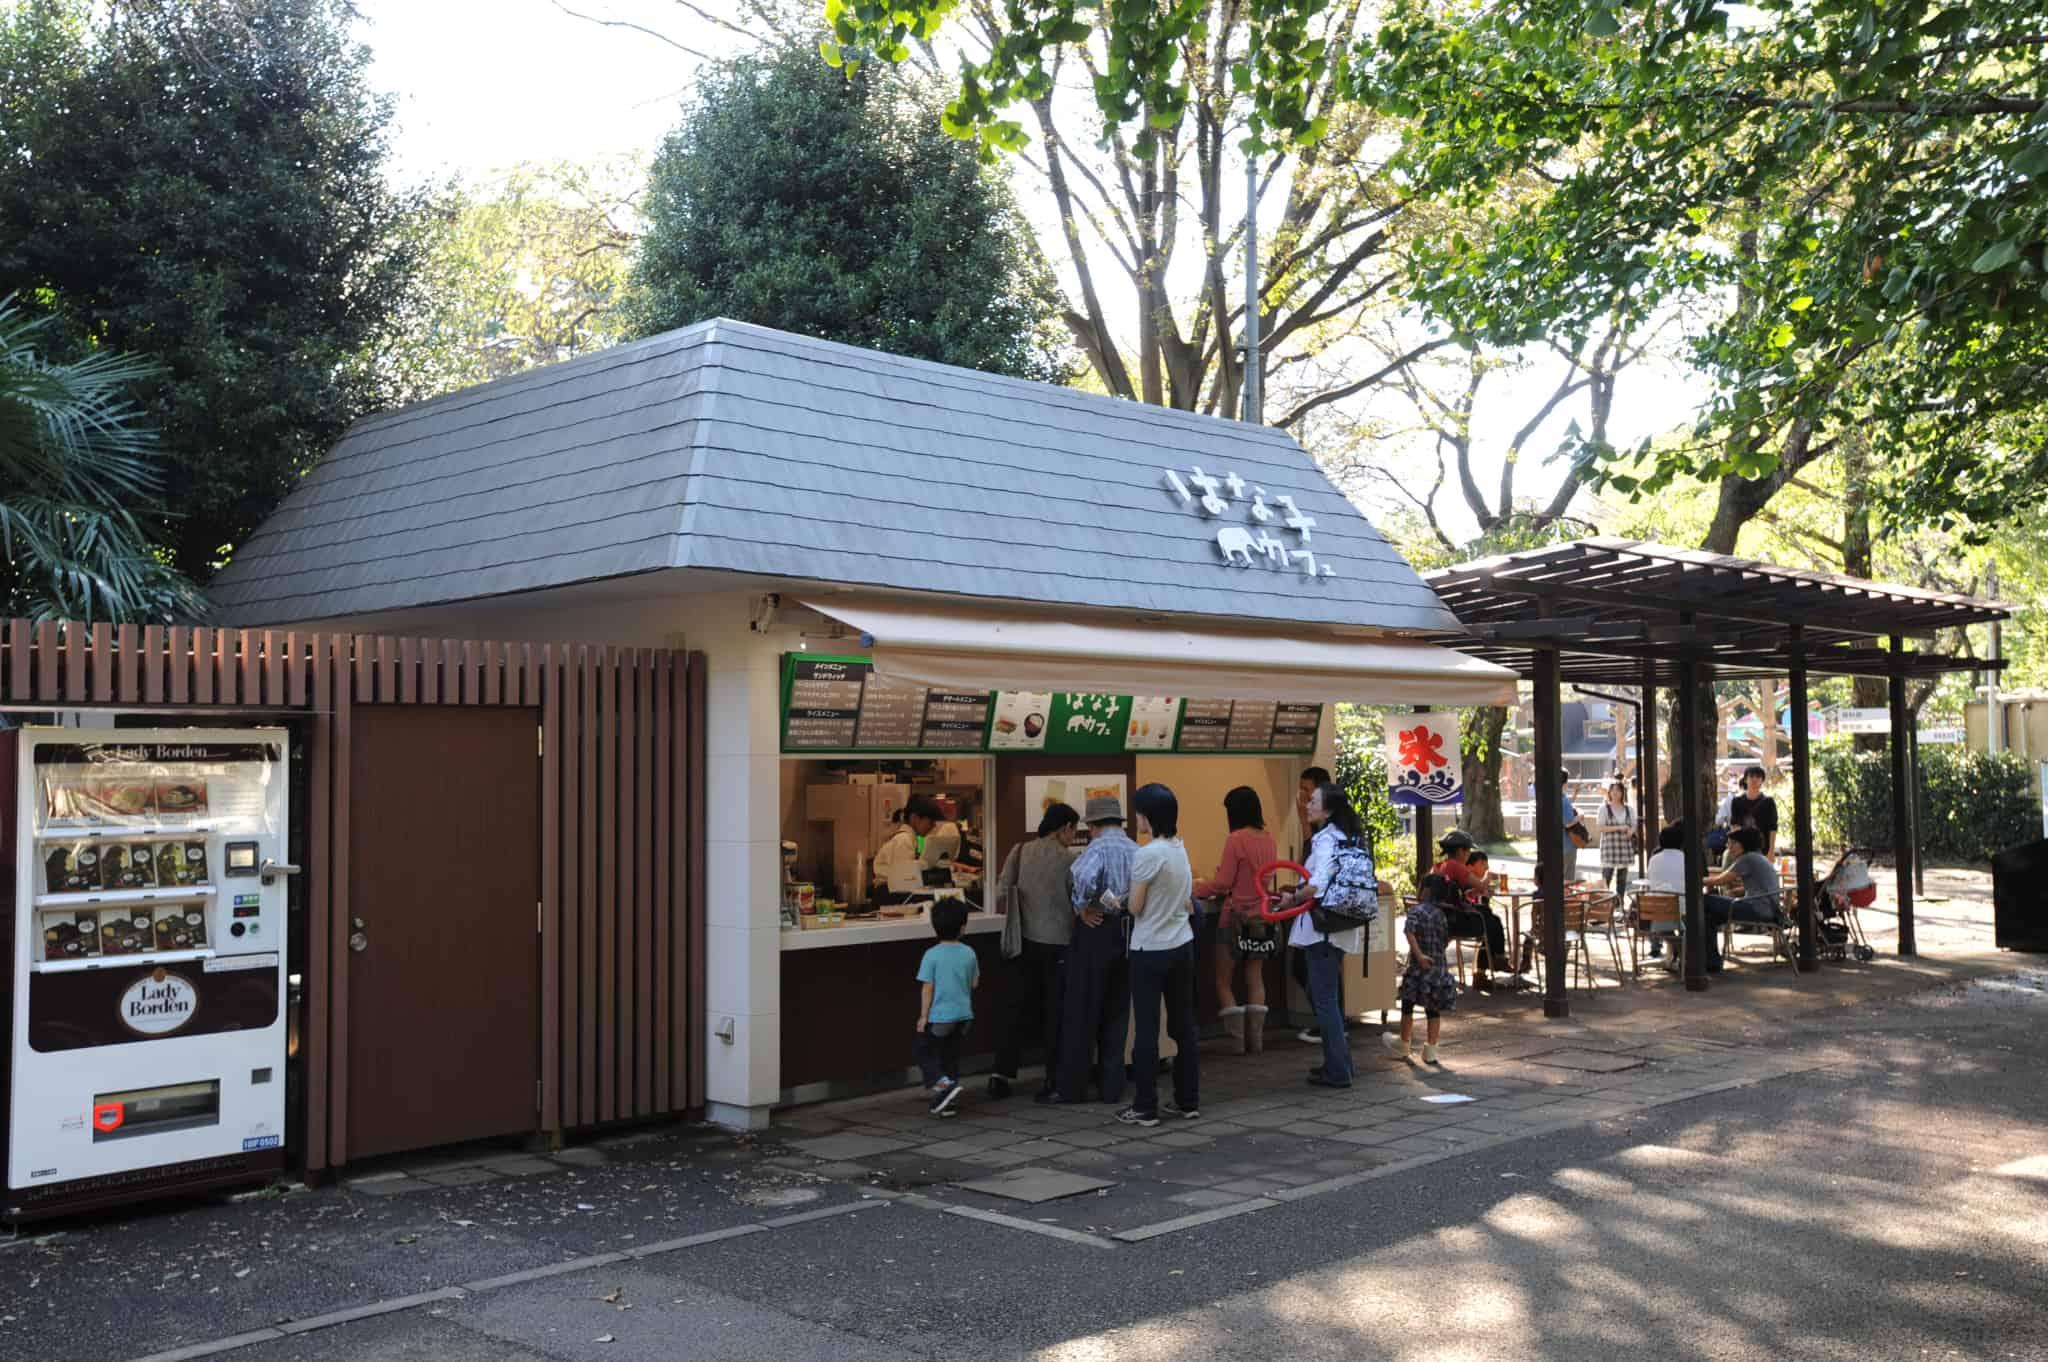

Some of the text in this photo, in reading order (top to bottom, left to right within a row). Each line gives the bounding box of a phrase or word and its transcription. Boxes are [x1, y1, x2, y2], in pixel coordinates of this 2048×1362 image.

[116, 744, 208, 760] Lady Borden
[1398, 725, 1449, 775] 氷
[141, 984, 179, 1002] Lady
[130, 1000, 189, 1017] Borden
